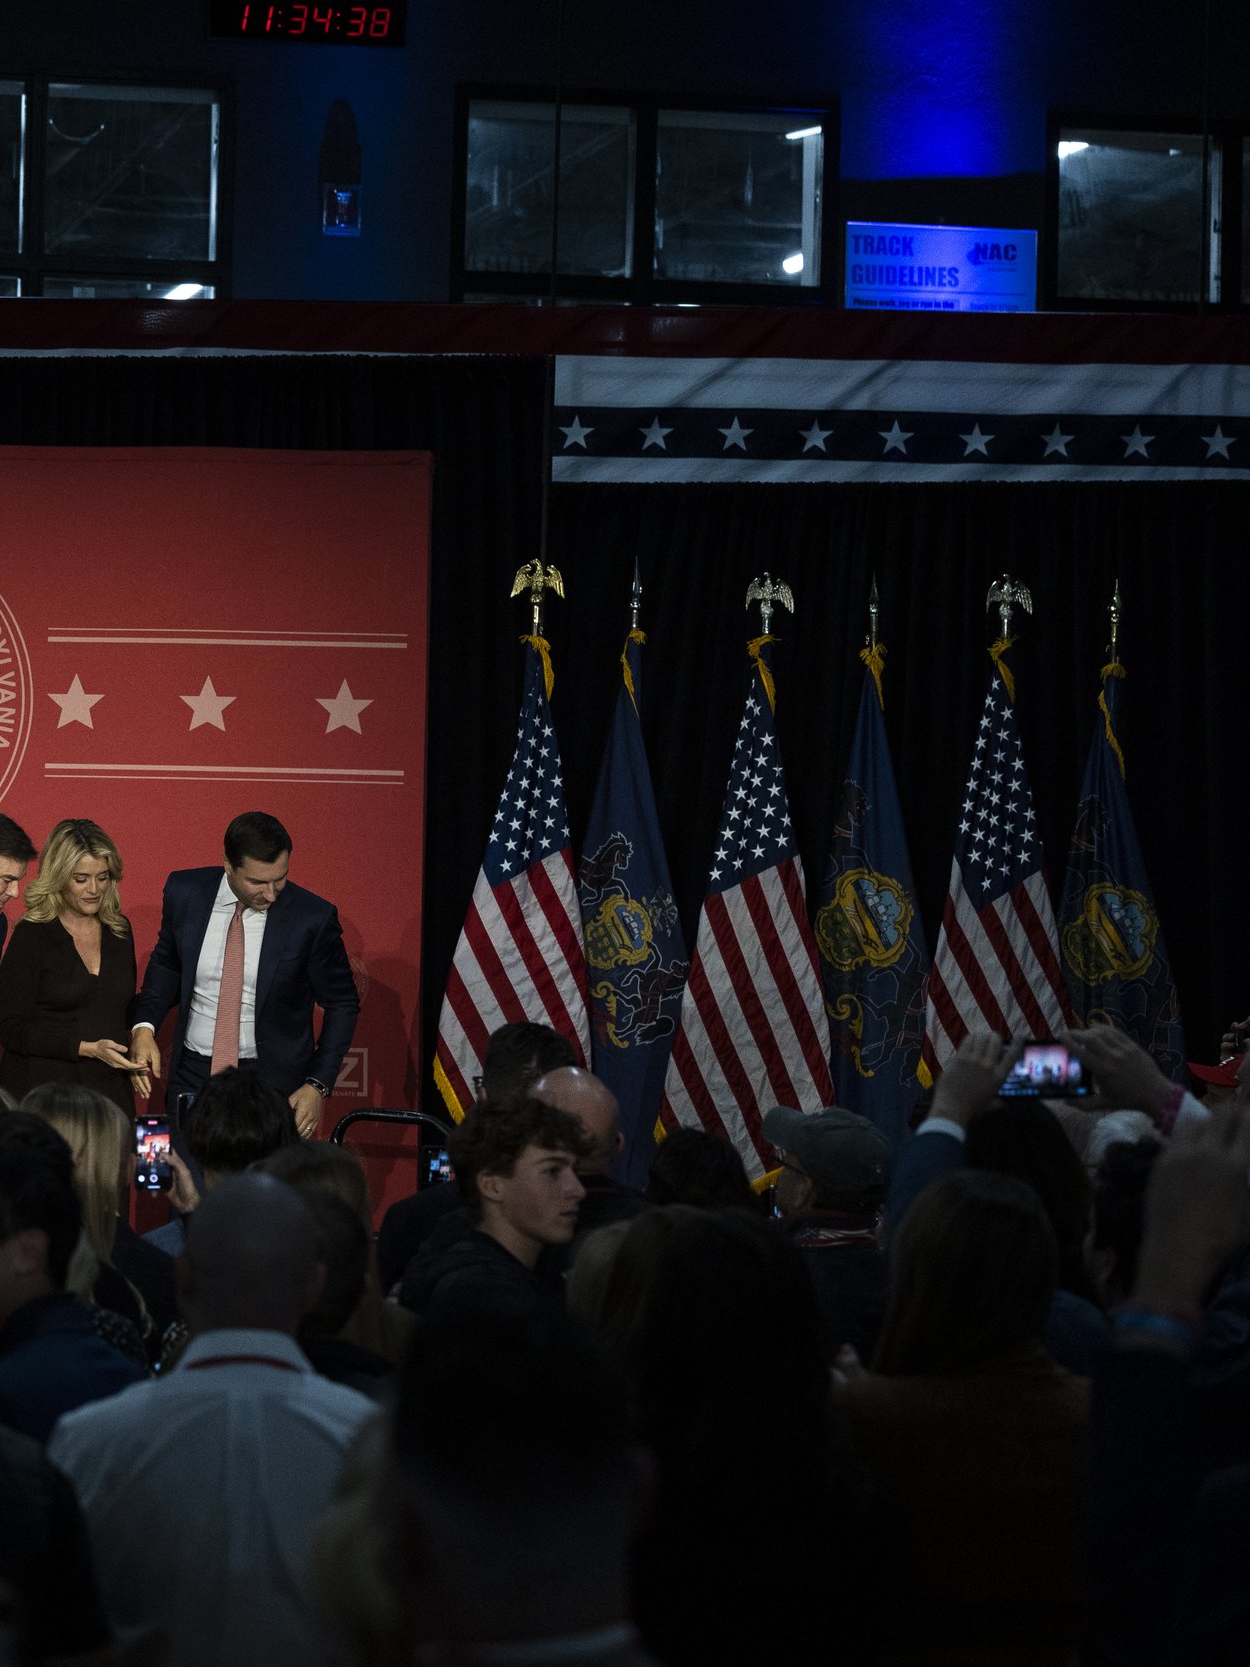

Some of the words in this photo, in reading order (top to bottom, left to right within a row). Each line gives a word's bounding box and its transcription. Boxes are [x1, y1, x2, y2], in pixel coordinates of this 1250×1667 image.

[241, 4, 391, 37] 11:34:38
[851, 234, 914, 257] TRACK
[975, 243, 1018, 261] NAC
[851, 264, 959, 288] GUIDELINES
[334, 1056, 359, 1088] Z
